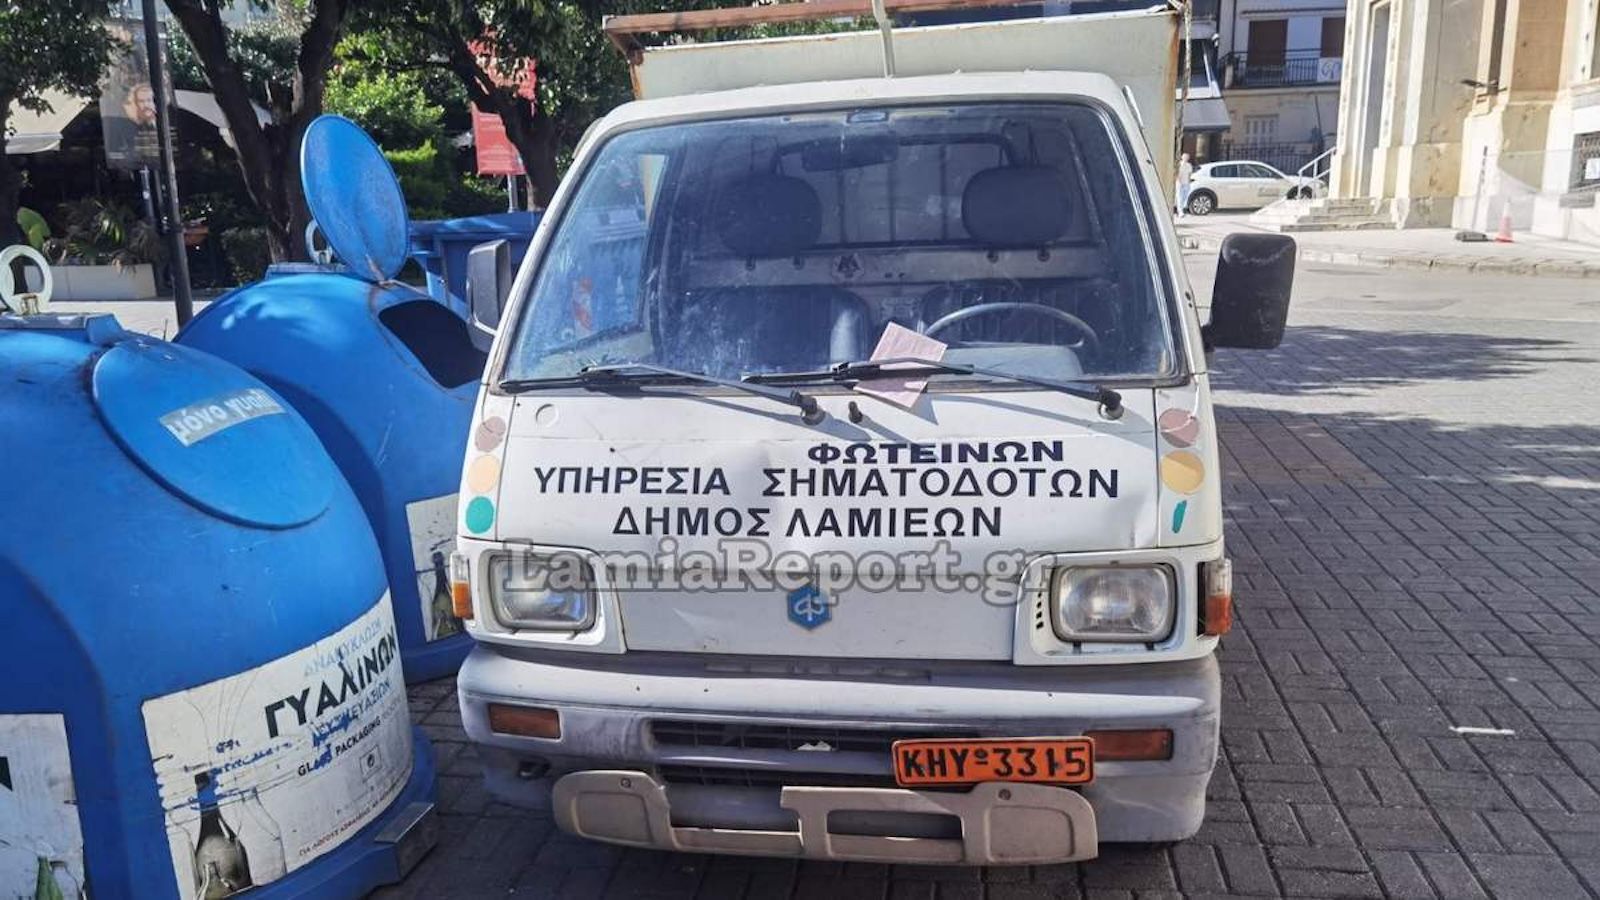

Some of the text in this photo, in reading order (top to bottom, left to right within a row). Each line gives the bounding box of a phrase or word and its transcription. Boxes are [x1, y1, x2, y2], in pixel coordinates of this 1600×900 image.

[807, 440, 1064, 465] ΦΩΤΕΙΝΩΝ
[534, 467, 1119, 498] ΥΠΗΡΕΣΙΑ ΣΗΜΑΤΟΔΟΤΩΝ
[612, 507, 1002, 538] ΔΗΜΟΣ ΛΑΜΙΕΩΝ
[264, 626, 397, 738] ΓΥΑΛΙΝΩΝ
[335, 716, 381, 756] PACKAGING
